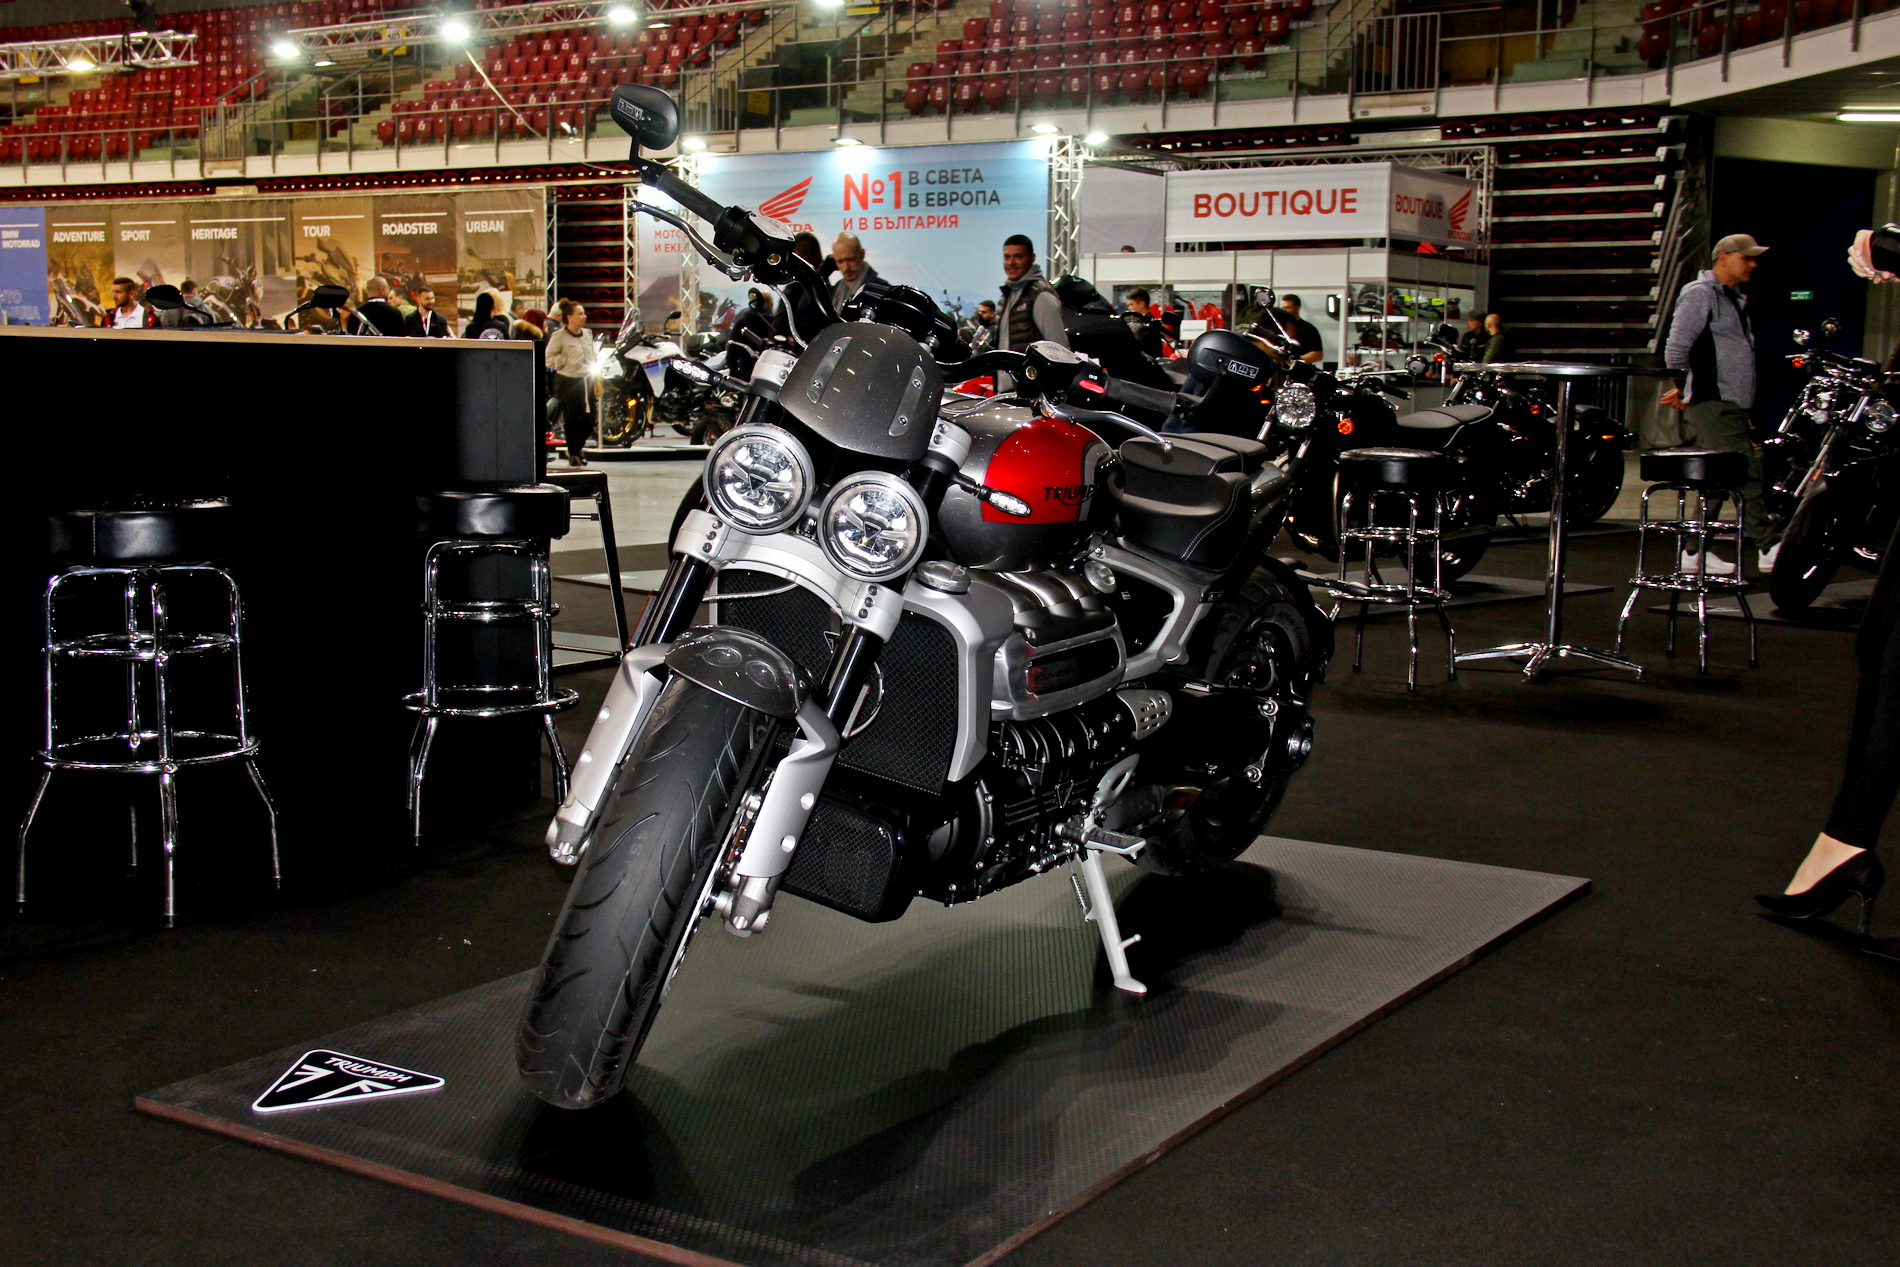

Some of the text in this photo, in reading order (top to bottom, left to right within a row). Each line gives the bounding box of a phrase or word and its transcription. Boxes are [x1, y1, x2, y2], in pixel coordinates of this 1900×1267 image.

[925, 168, 984, 185] СВЕТА
[925, 190, 1001, 207] ЕВРОПА
[1193, 188, 1358, 218] BOUTIQUE
[1395, 194, 1443, 220] BOUTIQUE
[382, 222, 438, 236] ROADSTER
[465, 220, 505, 233] URBAN
[843, 218, 853, 231] И
[873, 214, 959, 230] БЪЛГАРИЯ
[2, 230, 20, 239] BMW
[52, 231, 106, 243] ADVENTURE
[120, 229, 151, 242] SPORT
[191, 227, 238, 240] HERITAGE
[302, 225, 331, 237] TOUR
[2, 240, 41, 249] MOTORRAD
[324, 1056, 413, 1083] TRIUMPH
